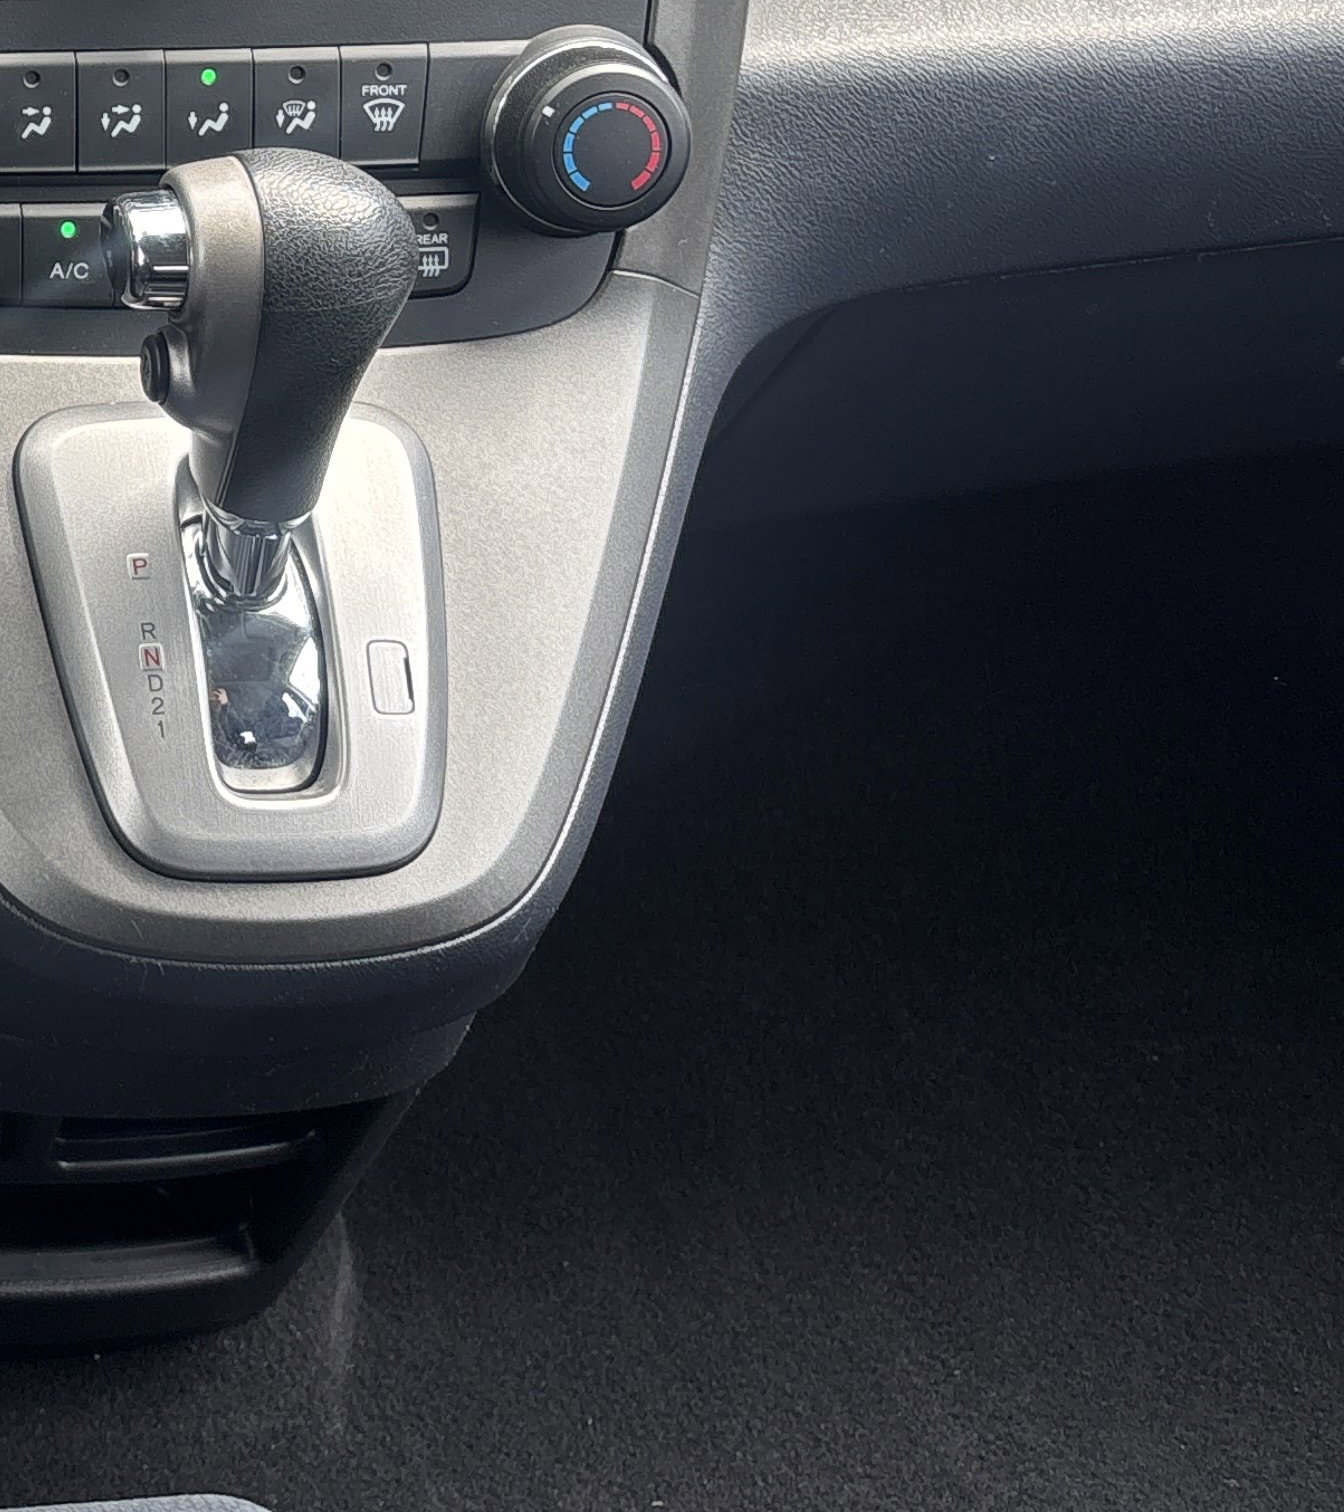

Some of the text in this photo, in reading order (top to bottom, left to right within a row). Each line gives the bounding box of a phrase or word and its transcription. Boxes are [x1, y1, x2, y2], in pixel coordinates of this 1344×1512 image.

[362, 85, 407, 96] FRONT
[50, 263, 89, 279] A/C
[132, 558, 148, 574] P
[140, 623, 156, 640] R
[144, 648, 160, 665] N
[148, 675, 163, 691] D
[151, 697, 165, 715] 2
[157, 721, 165, 738] 1
